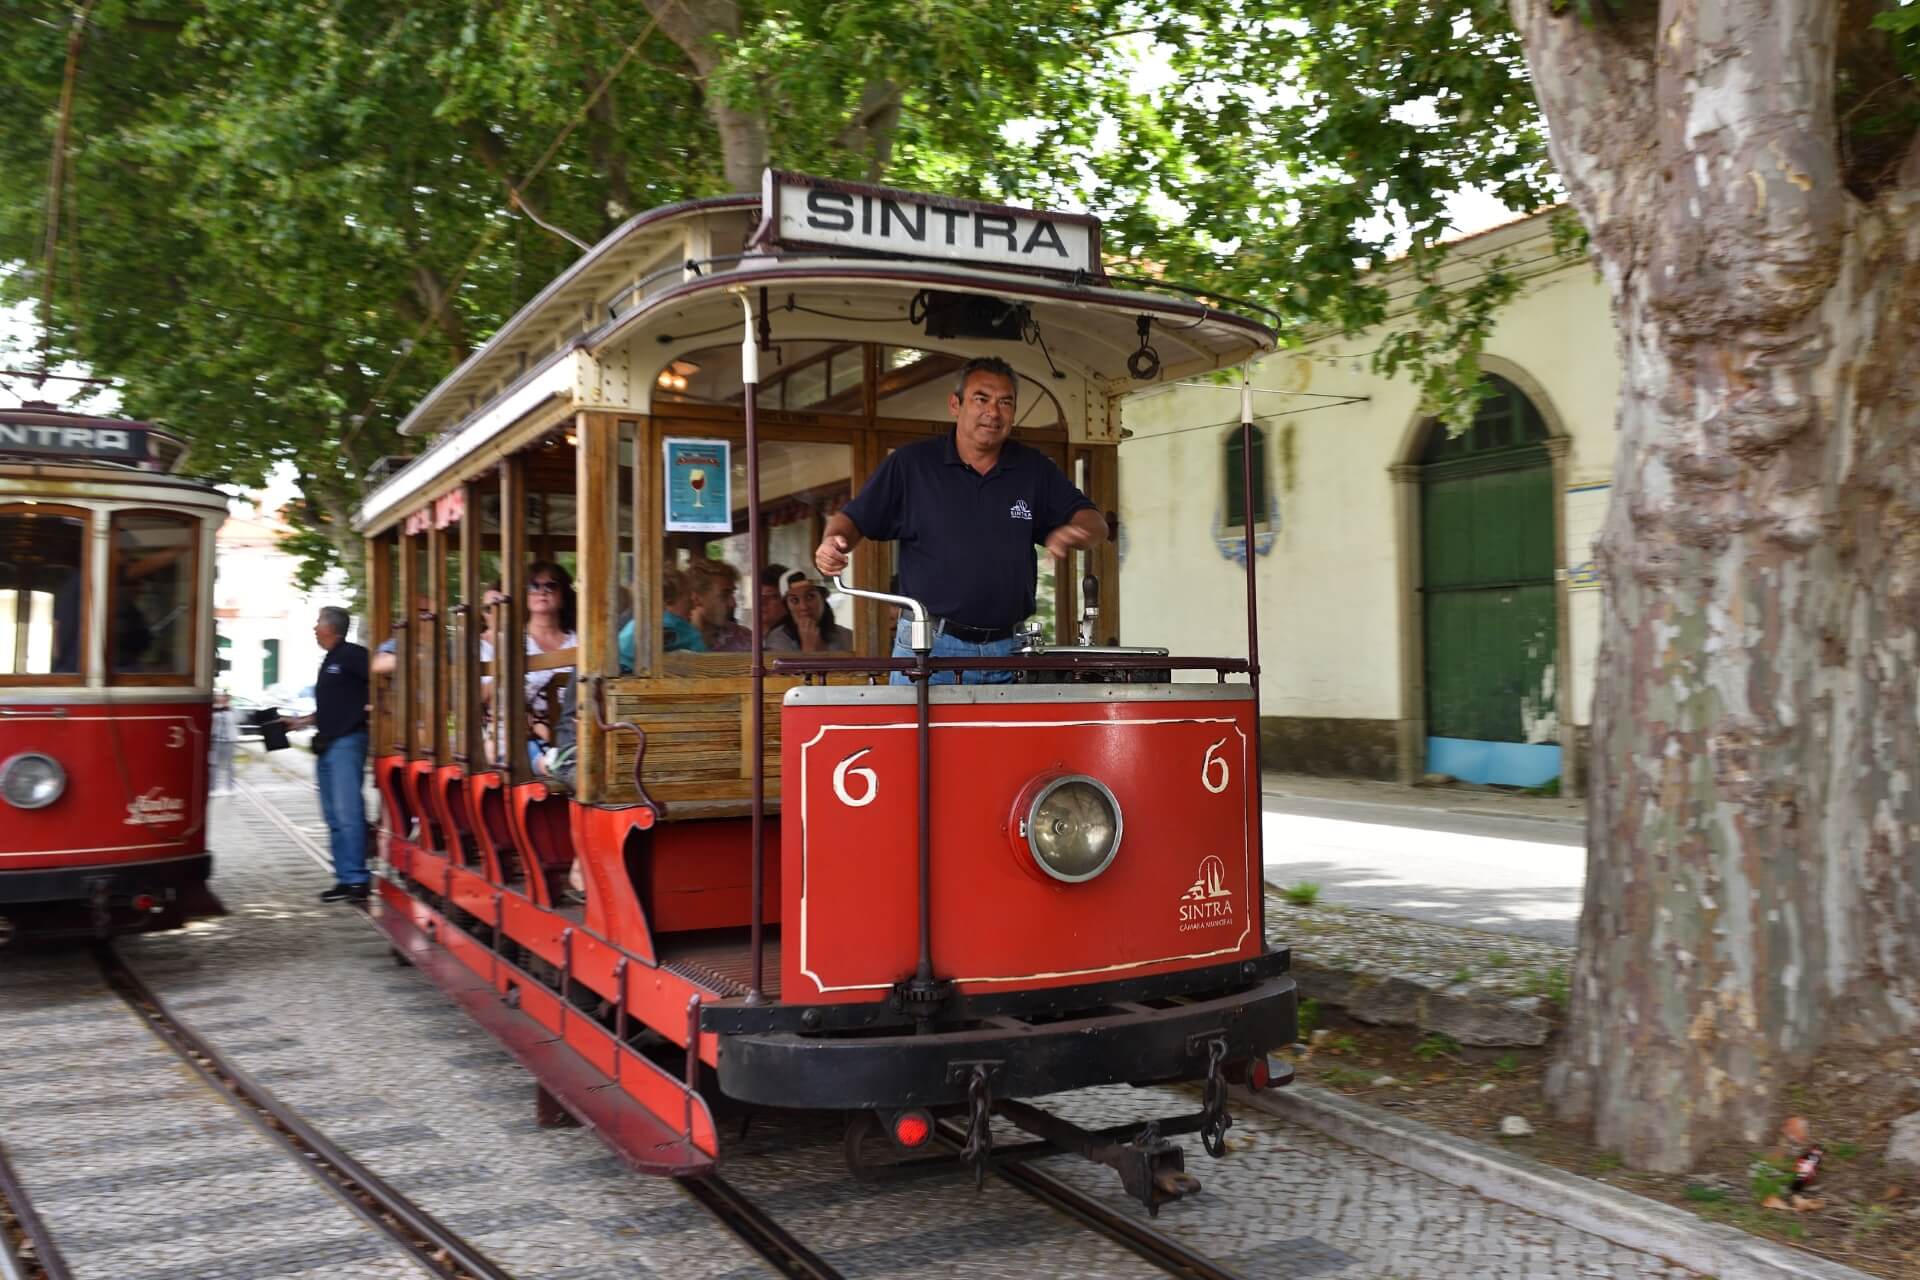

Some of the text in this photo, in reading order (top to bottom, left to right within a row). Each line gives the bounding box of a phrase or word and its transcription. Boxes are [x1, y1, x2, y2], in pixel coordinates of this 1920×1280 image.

[807, 190, 1069, 258] SINTRA
[166, 725, 186, 748] 3
[832, 746, 880, 808] 6
[1200, 737, 1230, 794] 6
[1180, 901, 1232, 920] SINTRA
